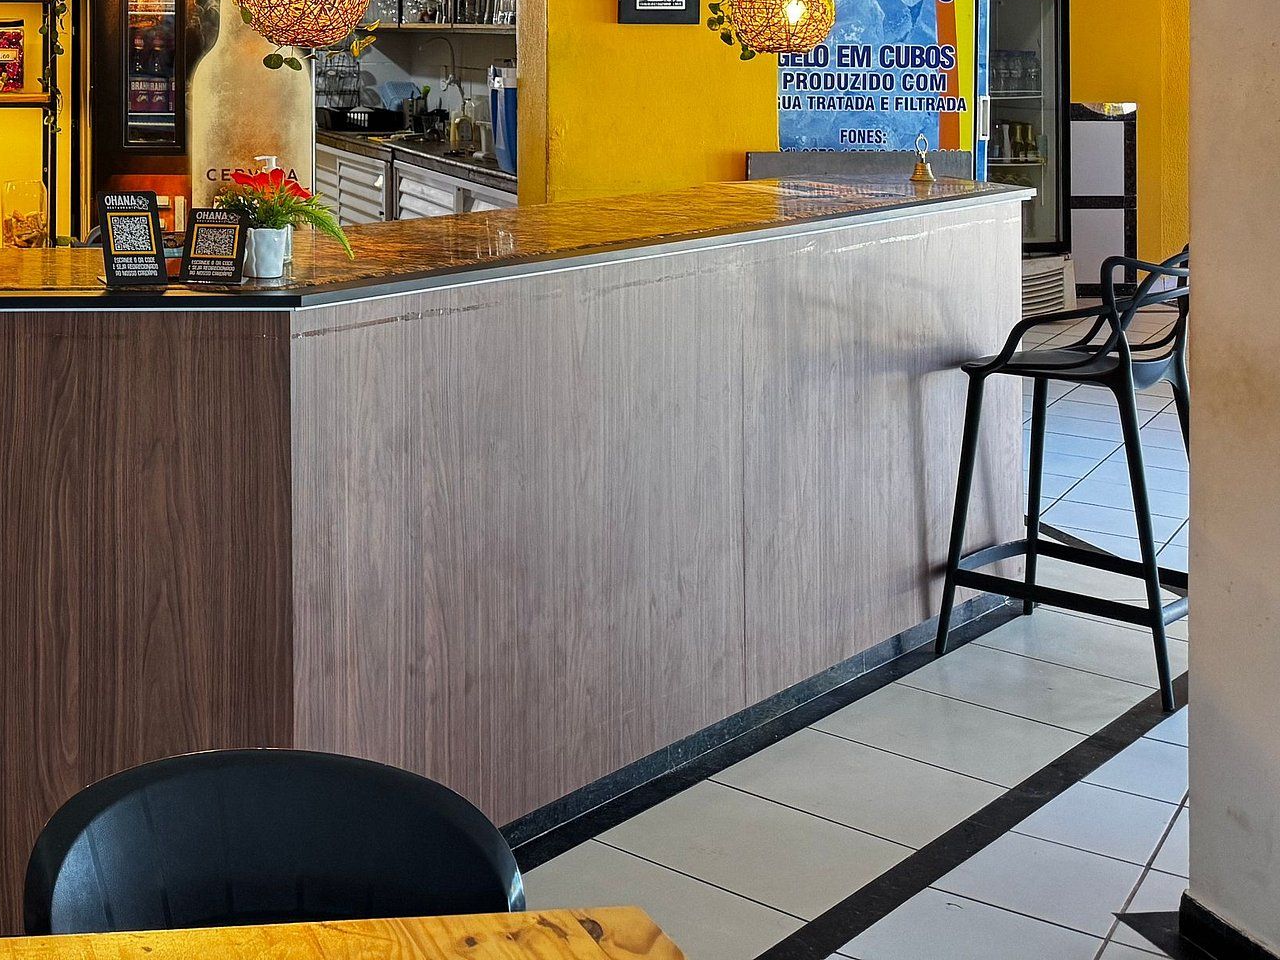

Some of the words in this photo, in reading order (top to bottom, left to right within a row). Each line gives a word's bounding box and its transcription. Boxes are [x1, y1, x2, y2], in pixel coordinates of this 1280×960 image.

[837, 46, 871, 68] EM
[879, 46, 955, 68] CUBOS
[783, 73, 894, 91] PRODUZIDO
[903, 74, 947, 91] COM
[778, 96, 802, 109] UA
[808, 97, 874, 110] TRATADA
[881, 97, 889, 110] E
[895, 97, 967, 111] FILTRADA
[841, 129, 887, 143] FONES:
[104, 195, 136, 206] OHANA
[196, 211, 228, 220] OHANA
